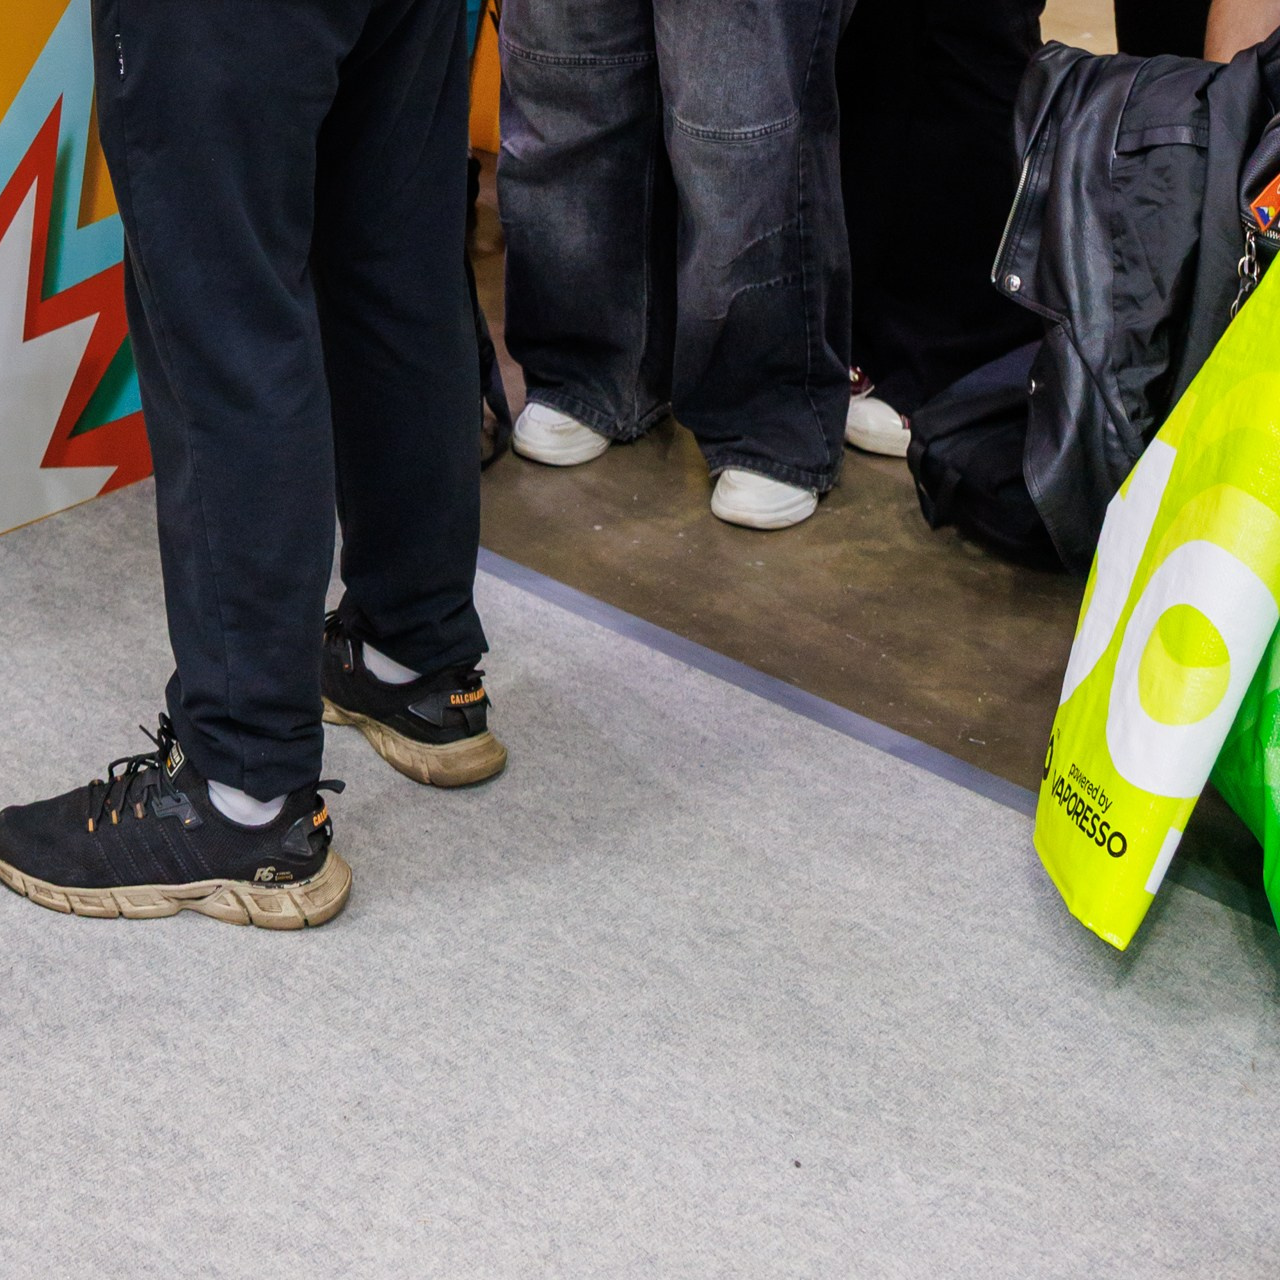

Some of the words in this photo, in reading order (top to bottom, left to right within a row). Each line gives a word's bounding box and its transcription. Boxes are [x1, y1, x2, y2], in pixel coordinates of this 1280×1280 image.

[1051, 768, 1128, 858] VAPORESSO
[1067, 763, 1101, 801] powered
[1097, 788, 1113, 814] by
